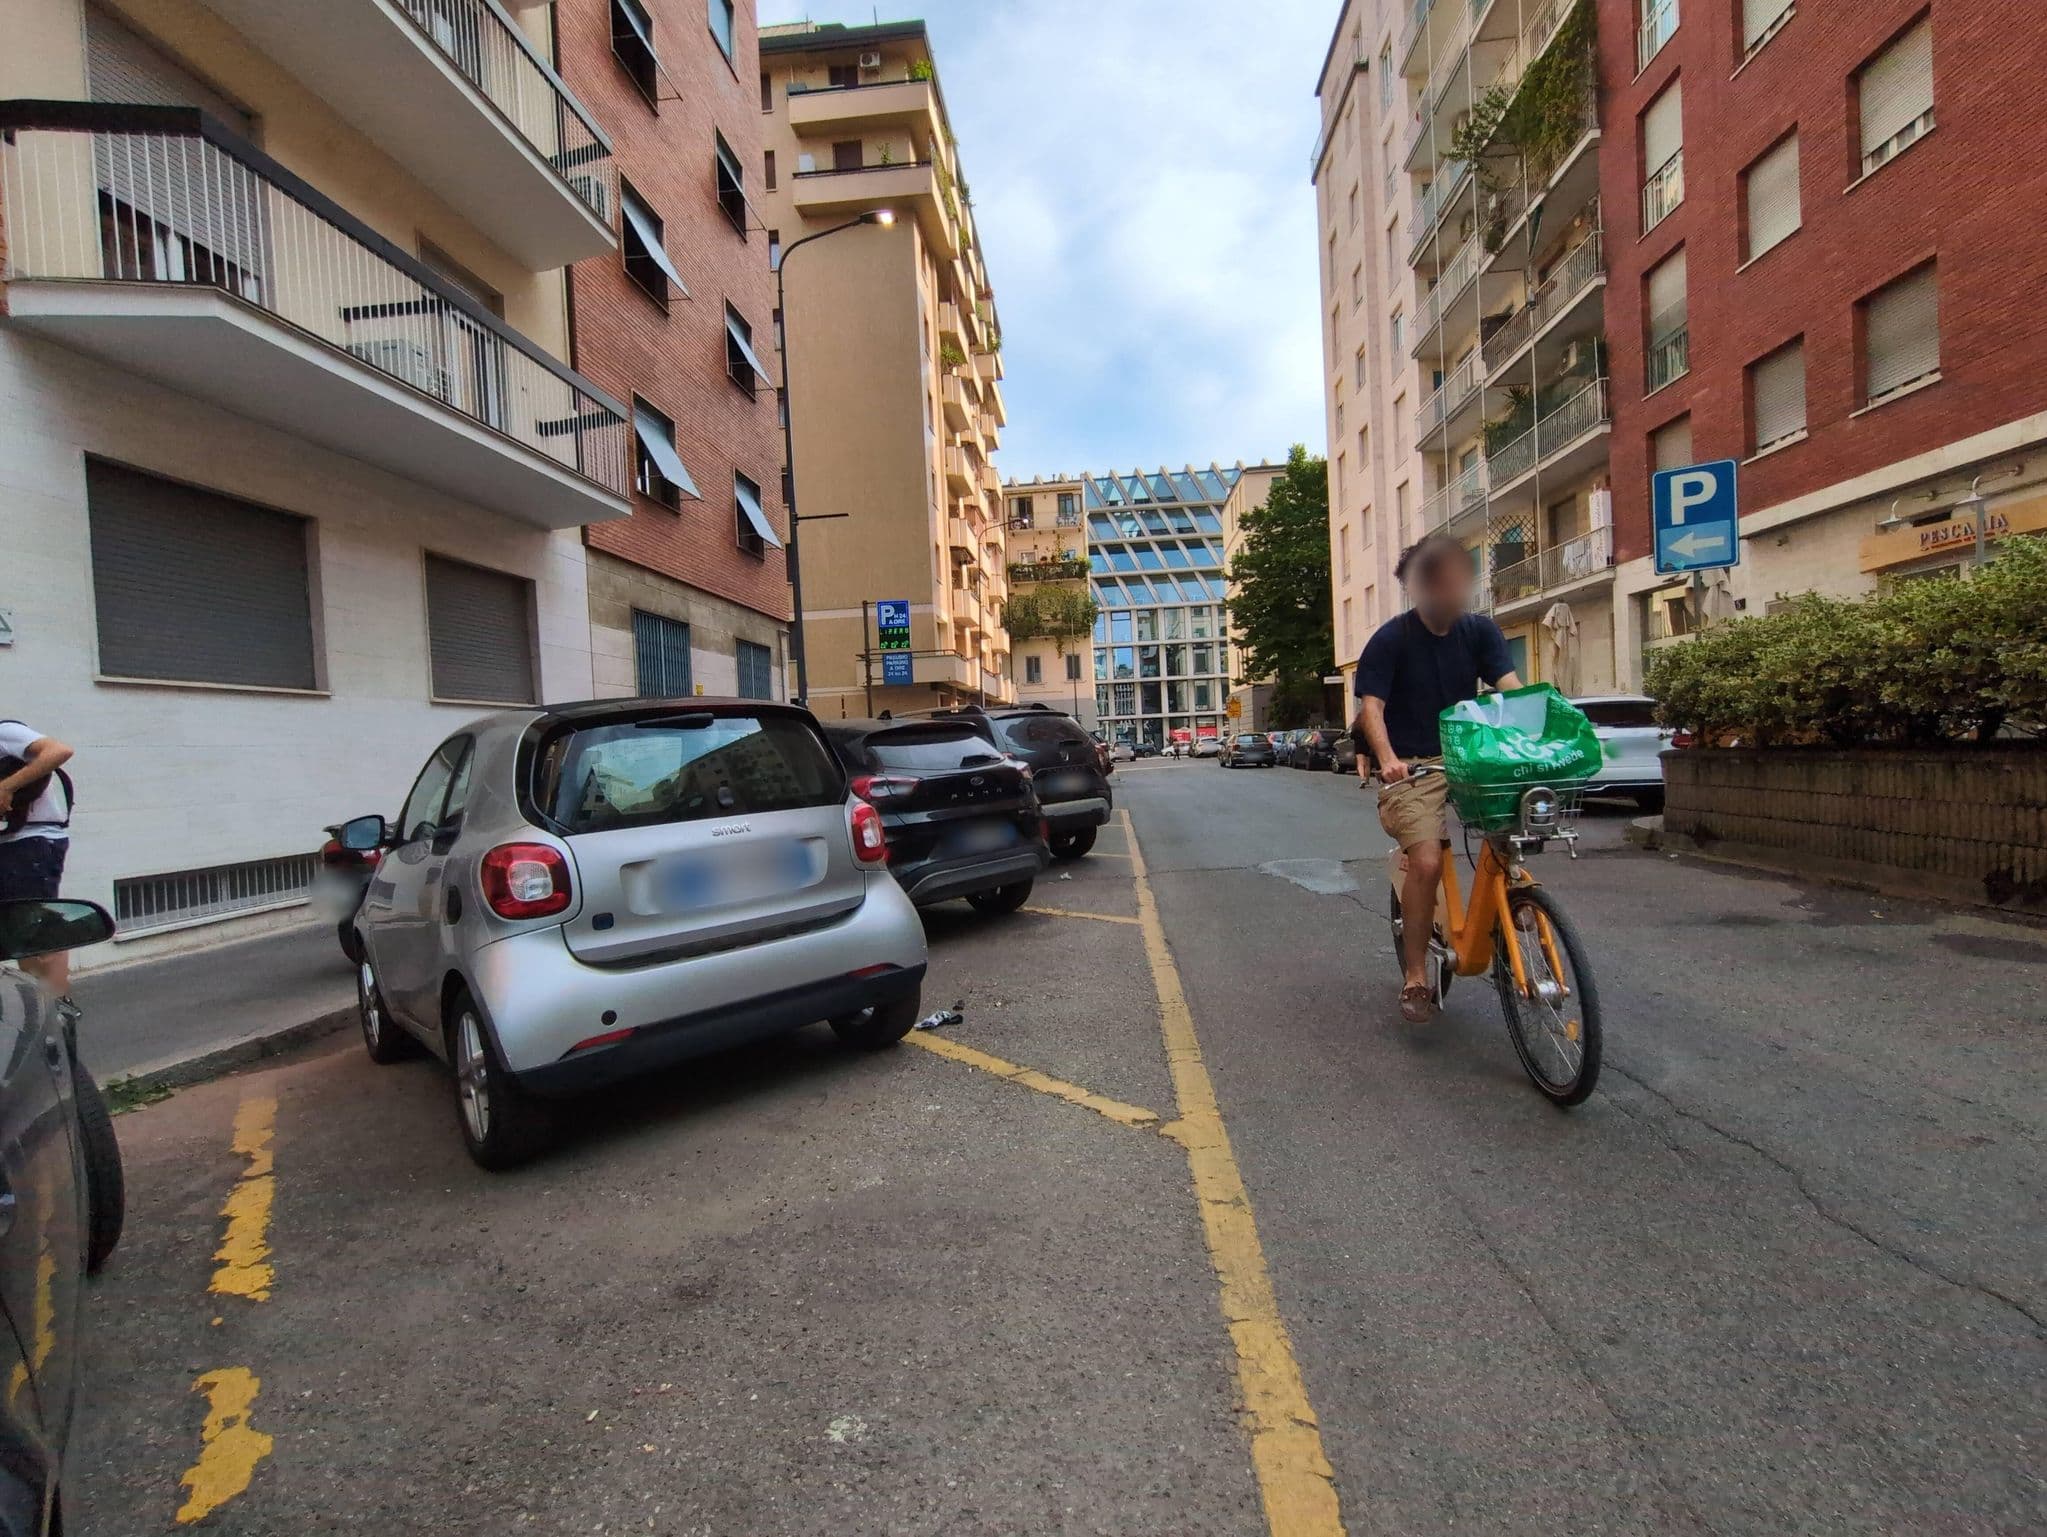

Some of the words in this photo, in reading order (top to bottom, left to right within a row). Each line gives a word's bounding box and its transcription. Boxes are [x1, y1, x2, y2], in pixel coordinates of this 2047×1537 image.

[1670, 471, 1717, 526] P
[1920, 513, 2009, 547] PESCAIA
[881, 605, 895, 625] P
[711, 823, 752, 837] smart
